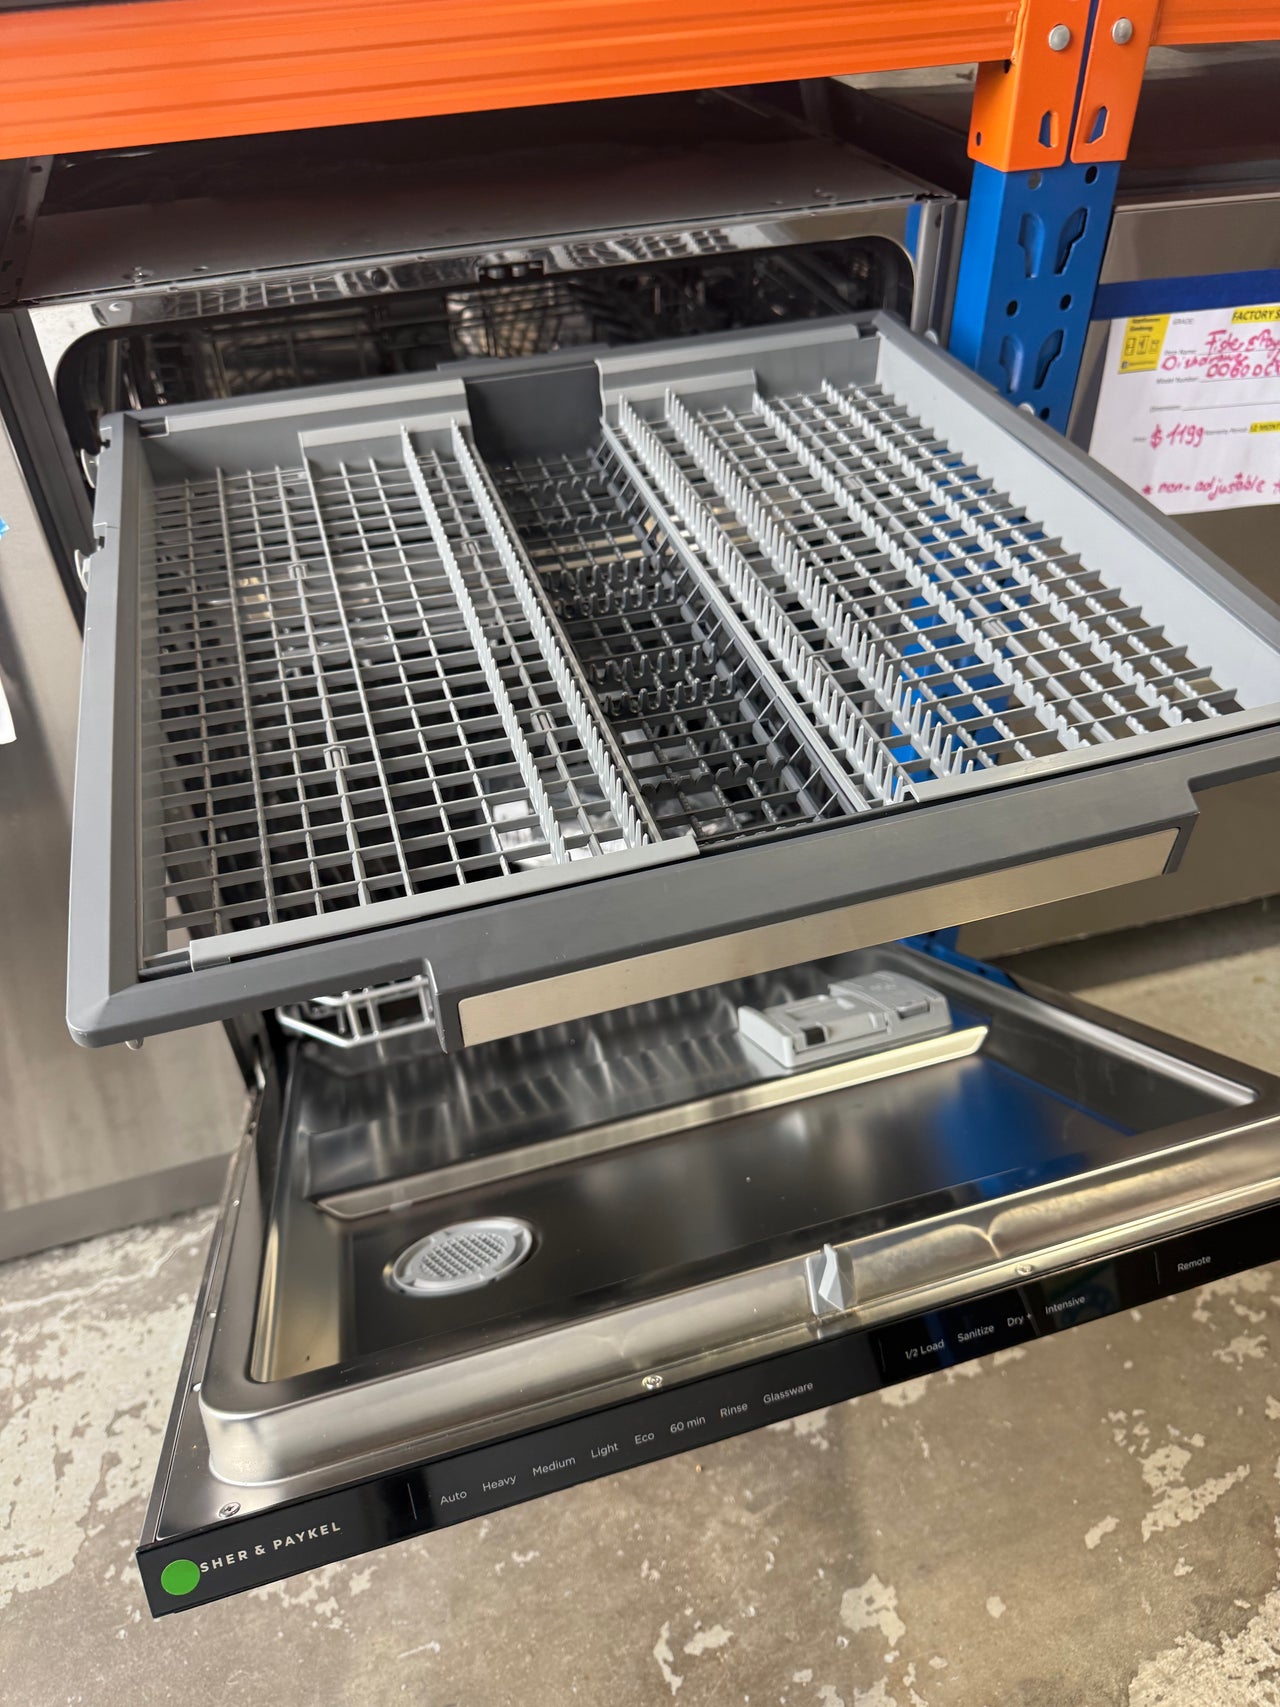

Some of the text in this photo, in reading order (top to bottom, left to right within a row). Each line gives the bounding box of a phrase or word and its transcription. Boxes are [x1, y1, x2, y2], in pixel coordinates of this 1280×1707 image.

[1232, 309, 1273, 321] FACTORY
[1177, 1254, 1212, 1272] Remote
[1045, 1294, 1086, 1315] Intensive
[957, 1322, 995, 1343] Sanitize
[905, 1338, 945, 1360] 1/2 Load
[762, 1381, 814, 1405] Glassware
[719, 1401, 748, 1419] Rinse
[669, 1415, 706, 1434] 60 min
[634, 1430, 655, 1445] Eco
[590, 1442, 619, 1459] Light
[532, 1455, 576, 1477] Medium
[482, 1473, 517, 1493] Heavy
[440, 1489, 467, 1506] Auto
[200, 1521, 342, 1573] SHER & PAYKEL
